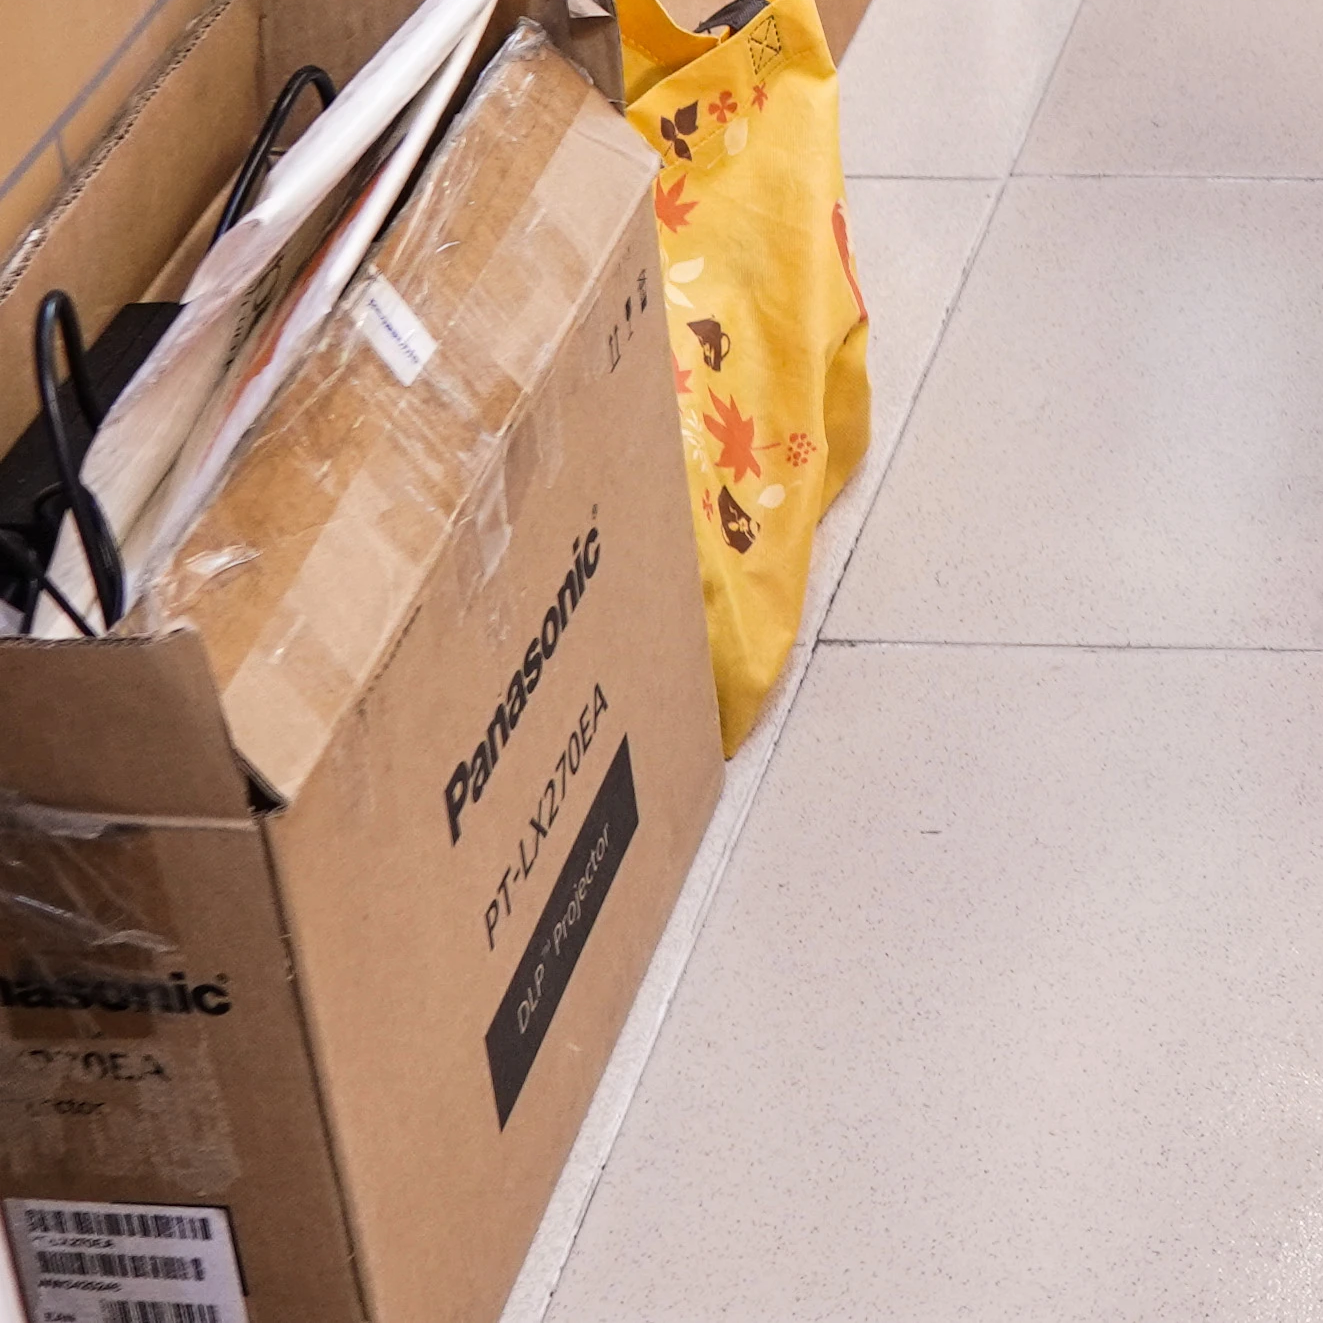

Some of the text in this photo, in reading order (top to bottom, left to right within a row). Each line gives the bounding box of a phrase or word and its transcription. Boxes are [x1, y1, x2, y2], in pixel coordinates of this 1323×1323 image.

[444, 525, 602, 848] Panasonic
[485, 681, 610, 952] PT-LX270EA
[552, 822, 611, 956] Projector
